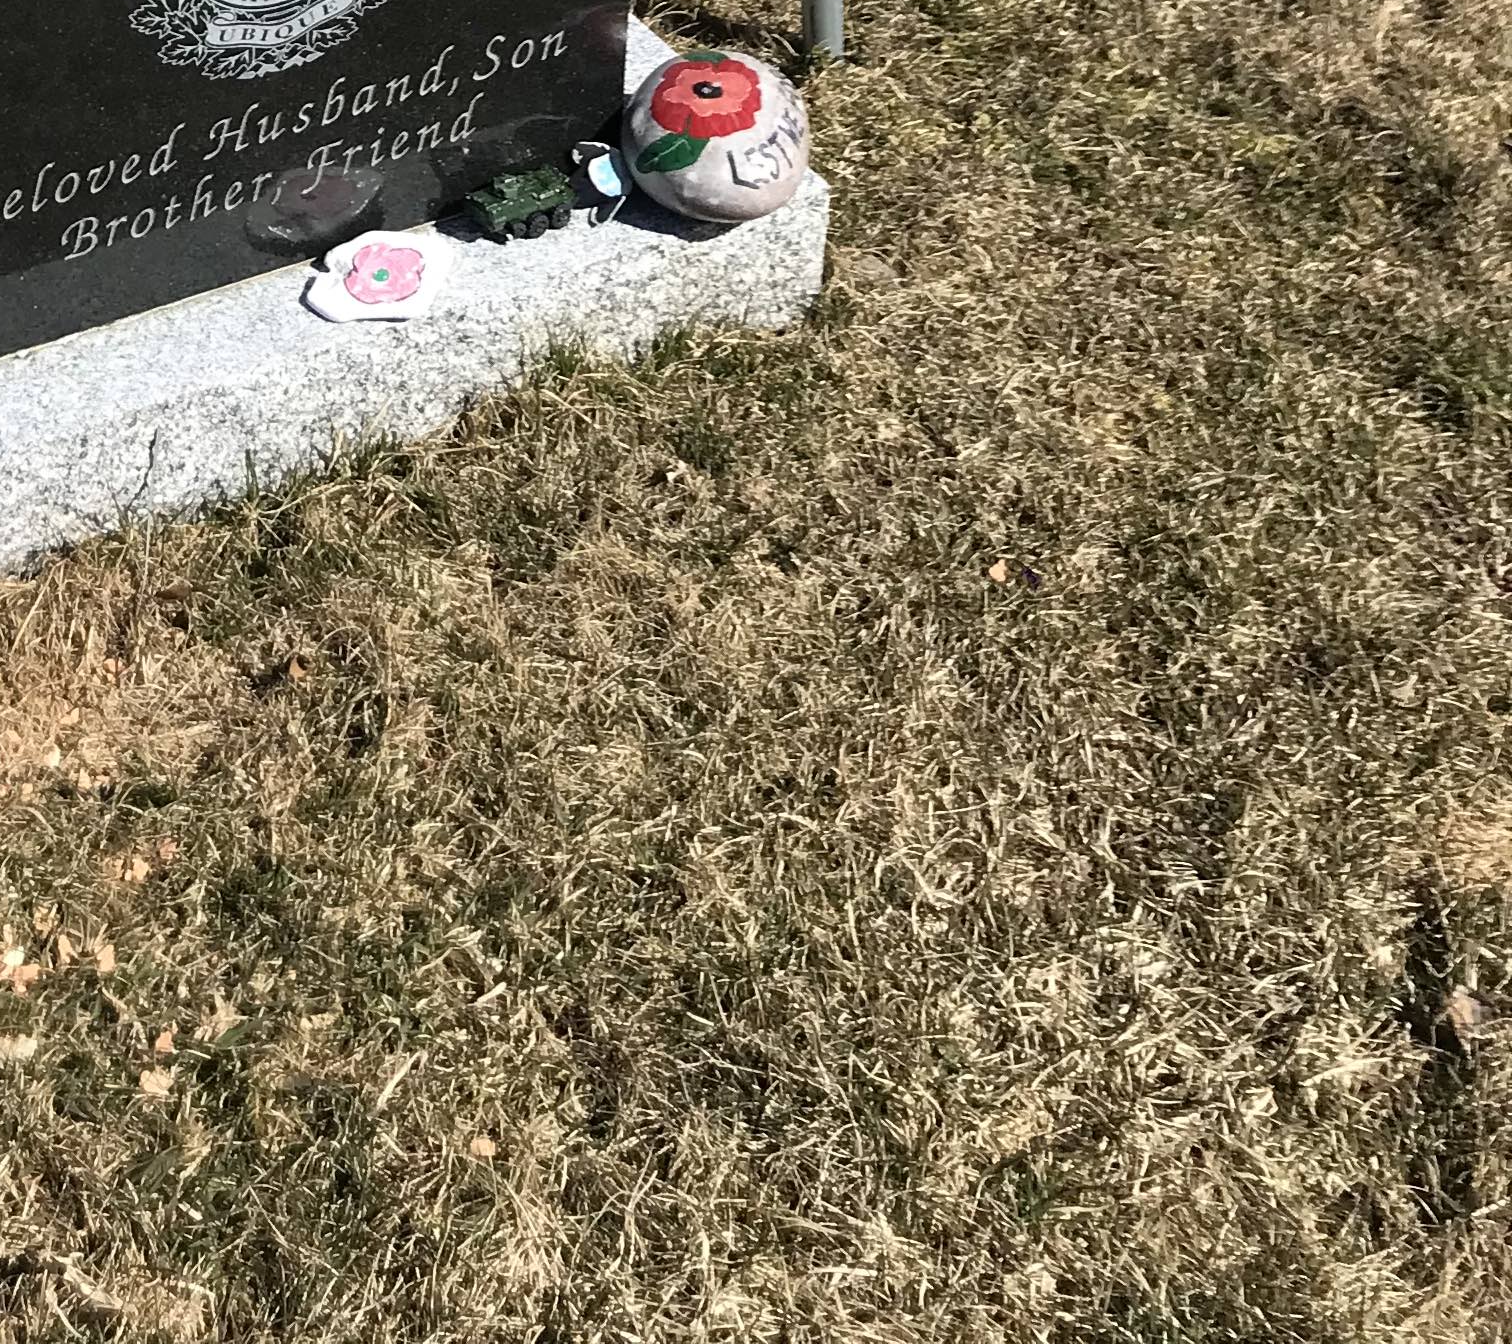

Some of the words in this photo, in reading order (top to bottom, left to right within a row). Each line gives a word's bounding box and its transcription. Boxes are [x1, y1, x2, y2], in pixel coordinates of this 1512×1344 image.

[202, 43, 460, 162] Husband,
[472, 29, 569, 82] Son
[60, 170, 285, 262] Brother,
[300, 91, 485, 196] Friend
